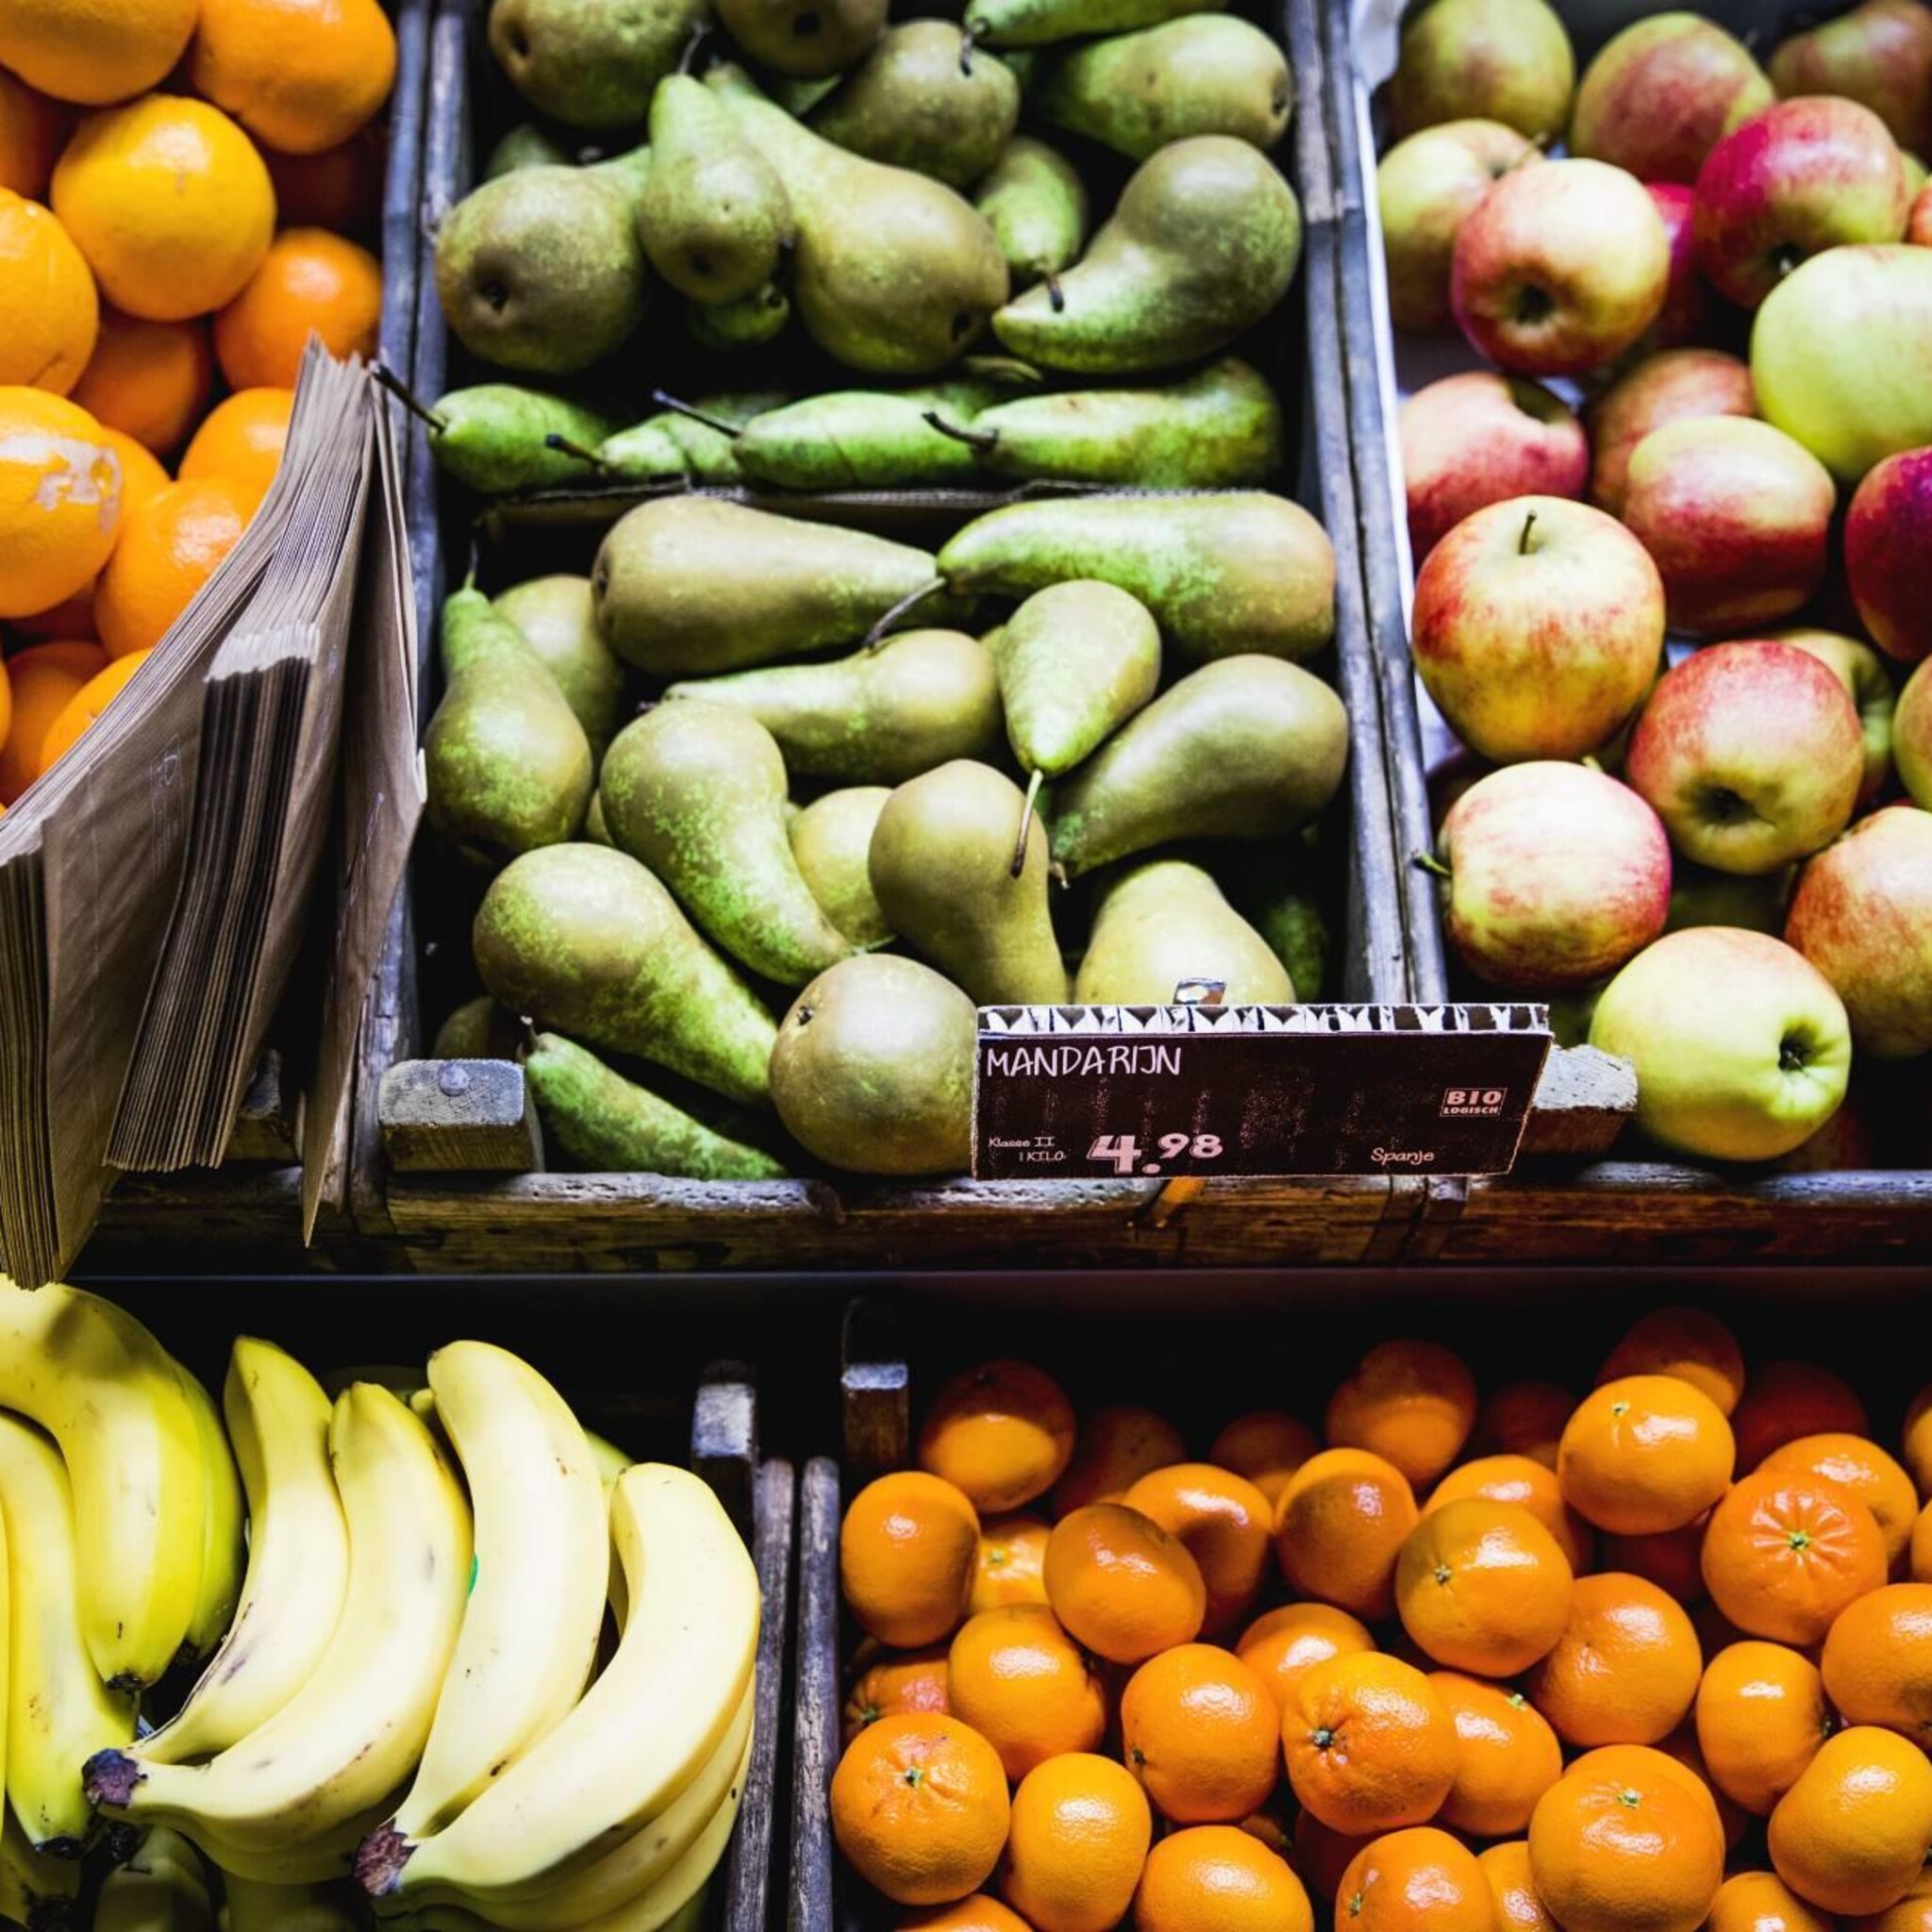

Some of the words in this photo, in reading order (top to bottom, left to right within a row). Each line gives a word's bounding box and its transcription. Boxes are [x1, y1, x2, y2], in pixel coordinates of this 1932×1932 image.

[987, 1045, 1181, 1076] MANDARIJN
[1446, 1091, 1502, 1106] BIO
[989, 1137, 1030, 1147] Klasse
[1034, 1136, 1055, 1147] II
[1086, 1133, 1224, 1174] 4.98
[1371, 1147, 1435, 1165] Spanje
